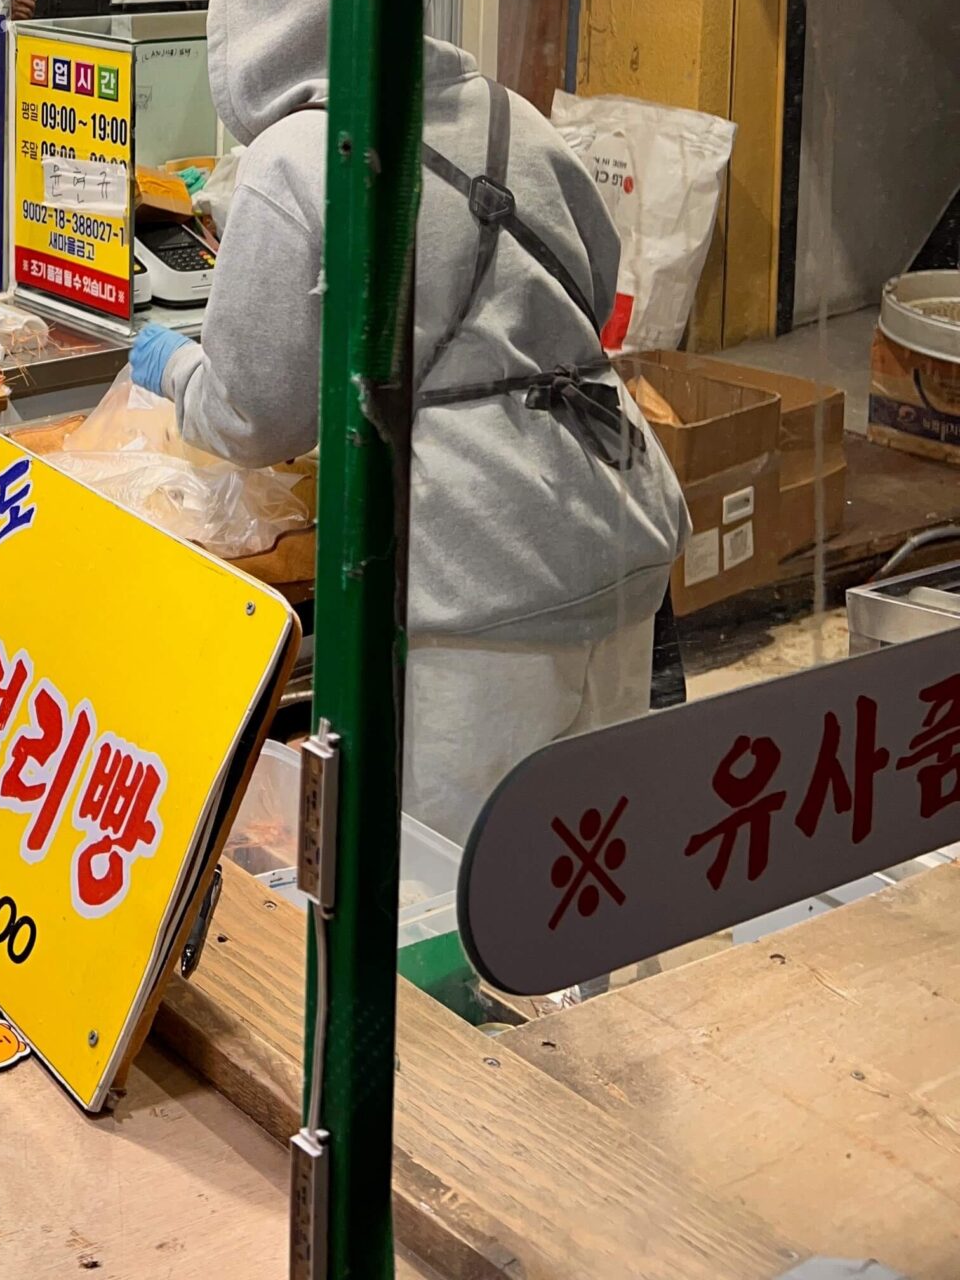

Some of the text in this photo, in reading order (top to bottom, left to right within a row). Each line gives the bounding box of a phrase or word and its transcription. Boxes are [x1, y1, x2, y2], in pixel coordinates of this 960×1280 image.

[30, 54, 119, 102] 영업시간
[21, 101, 38, 122] 평일
[21, 140, 38, 161] 주말
[611, 172, 624, 187] LG
[22, 200, 125, 247] 9002-18-388027-1
[49, 231, 95, 261] 새마을금고
[30, 260, 47, 280] 조기
[47, 265, 63, 285] 품절
[82, 276, 117, 303] 있습니다
